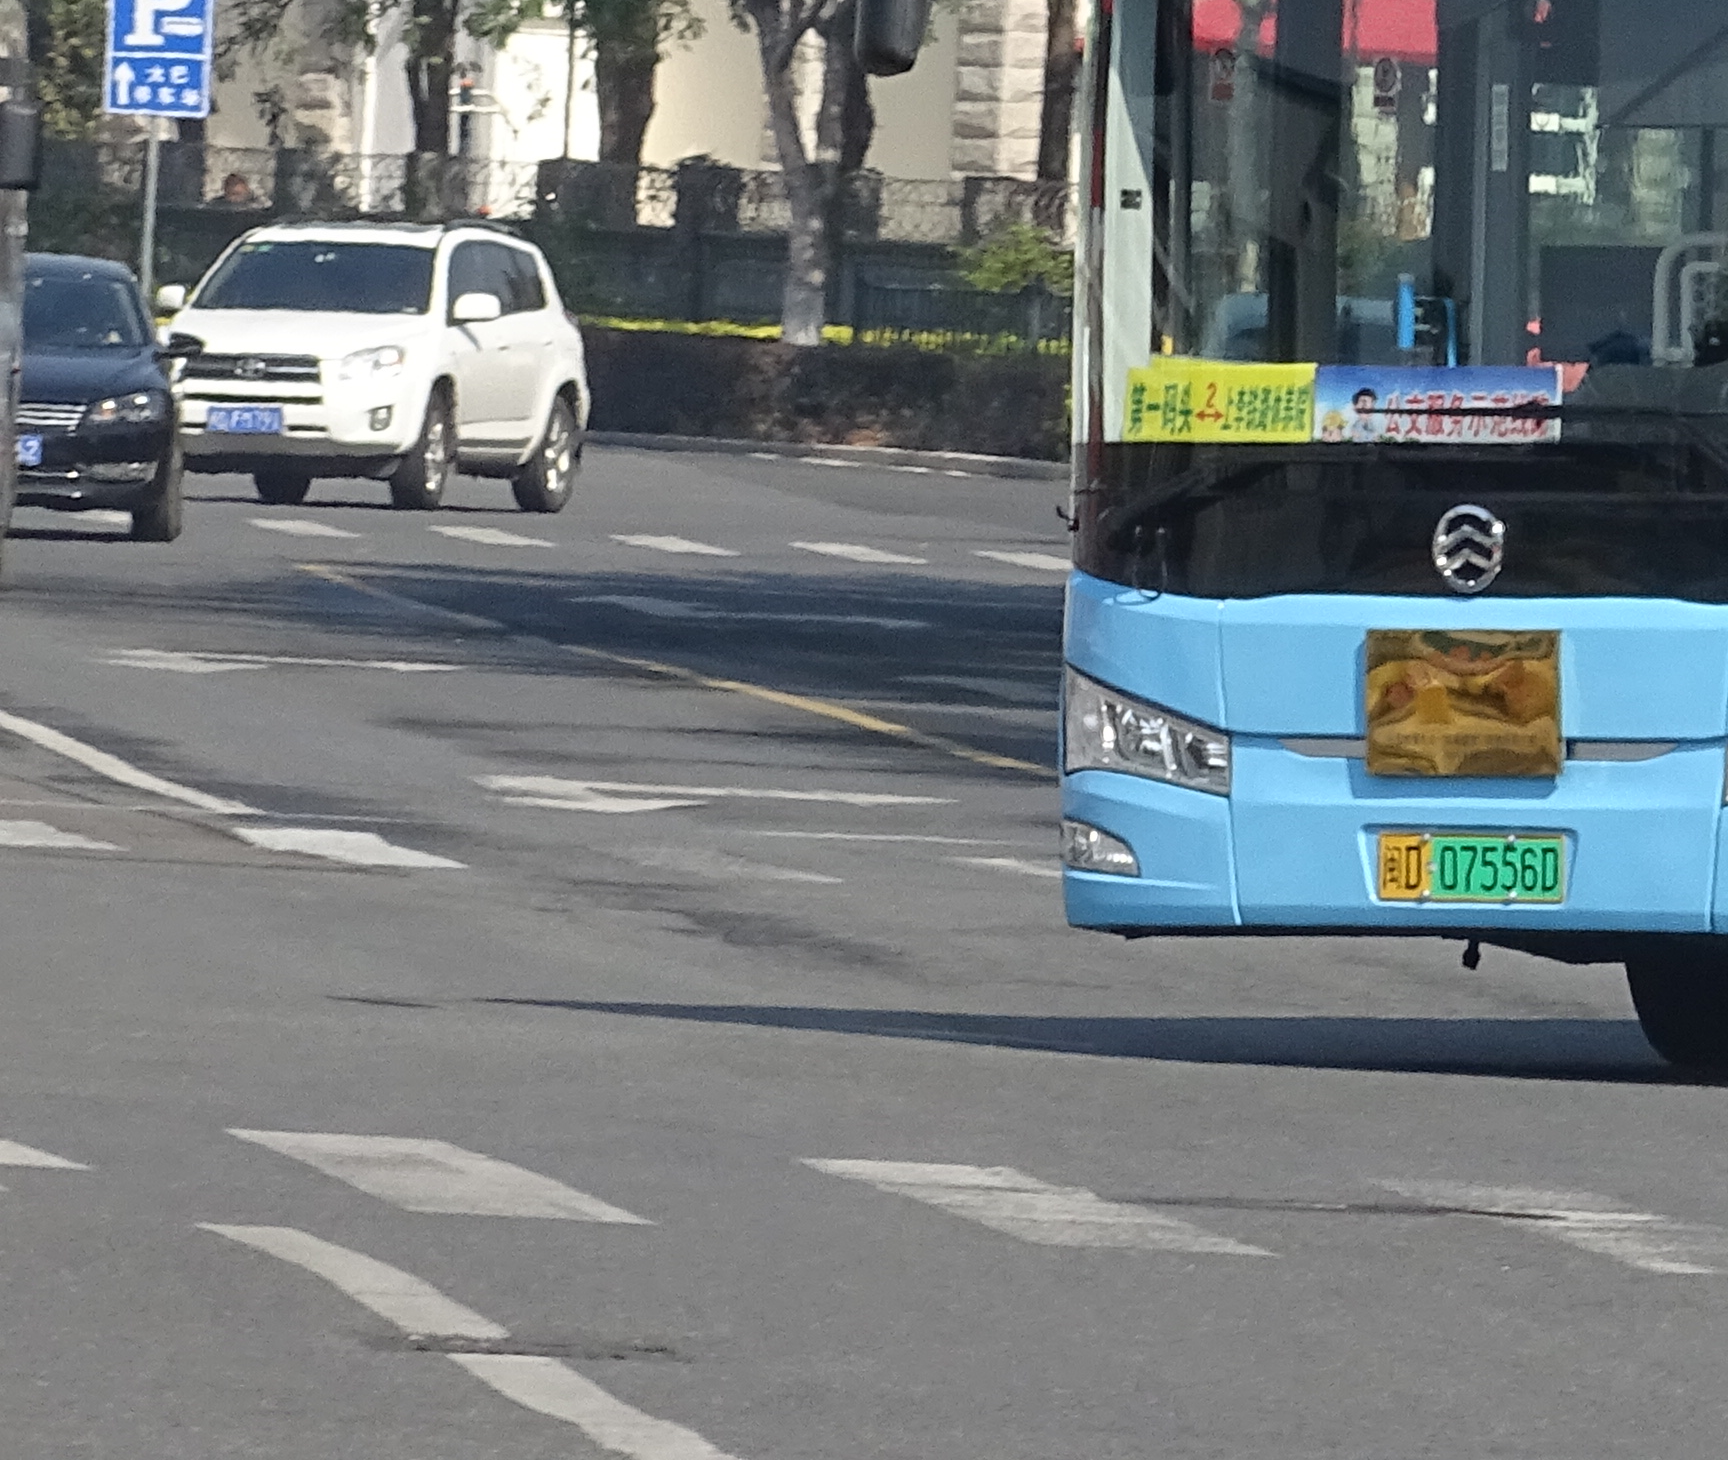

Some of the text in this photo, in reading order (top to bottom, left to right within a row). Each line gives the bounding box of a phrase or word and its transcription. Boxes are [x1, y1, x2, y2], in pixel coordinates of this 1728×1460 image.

[1128, 381, 1194, 436] 第一码头
[1205, 381, 1218, 409] 2
